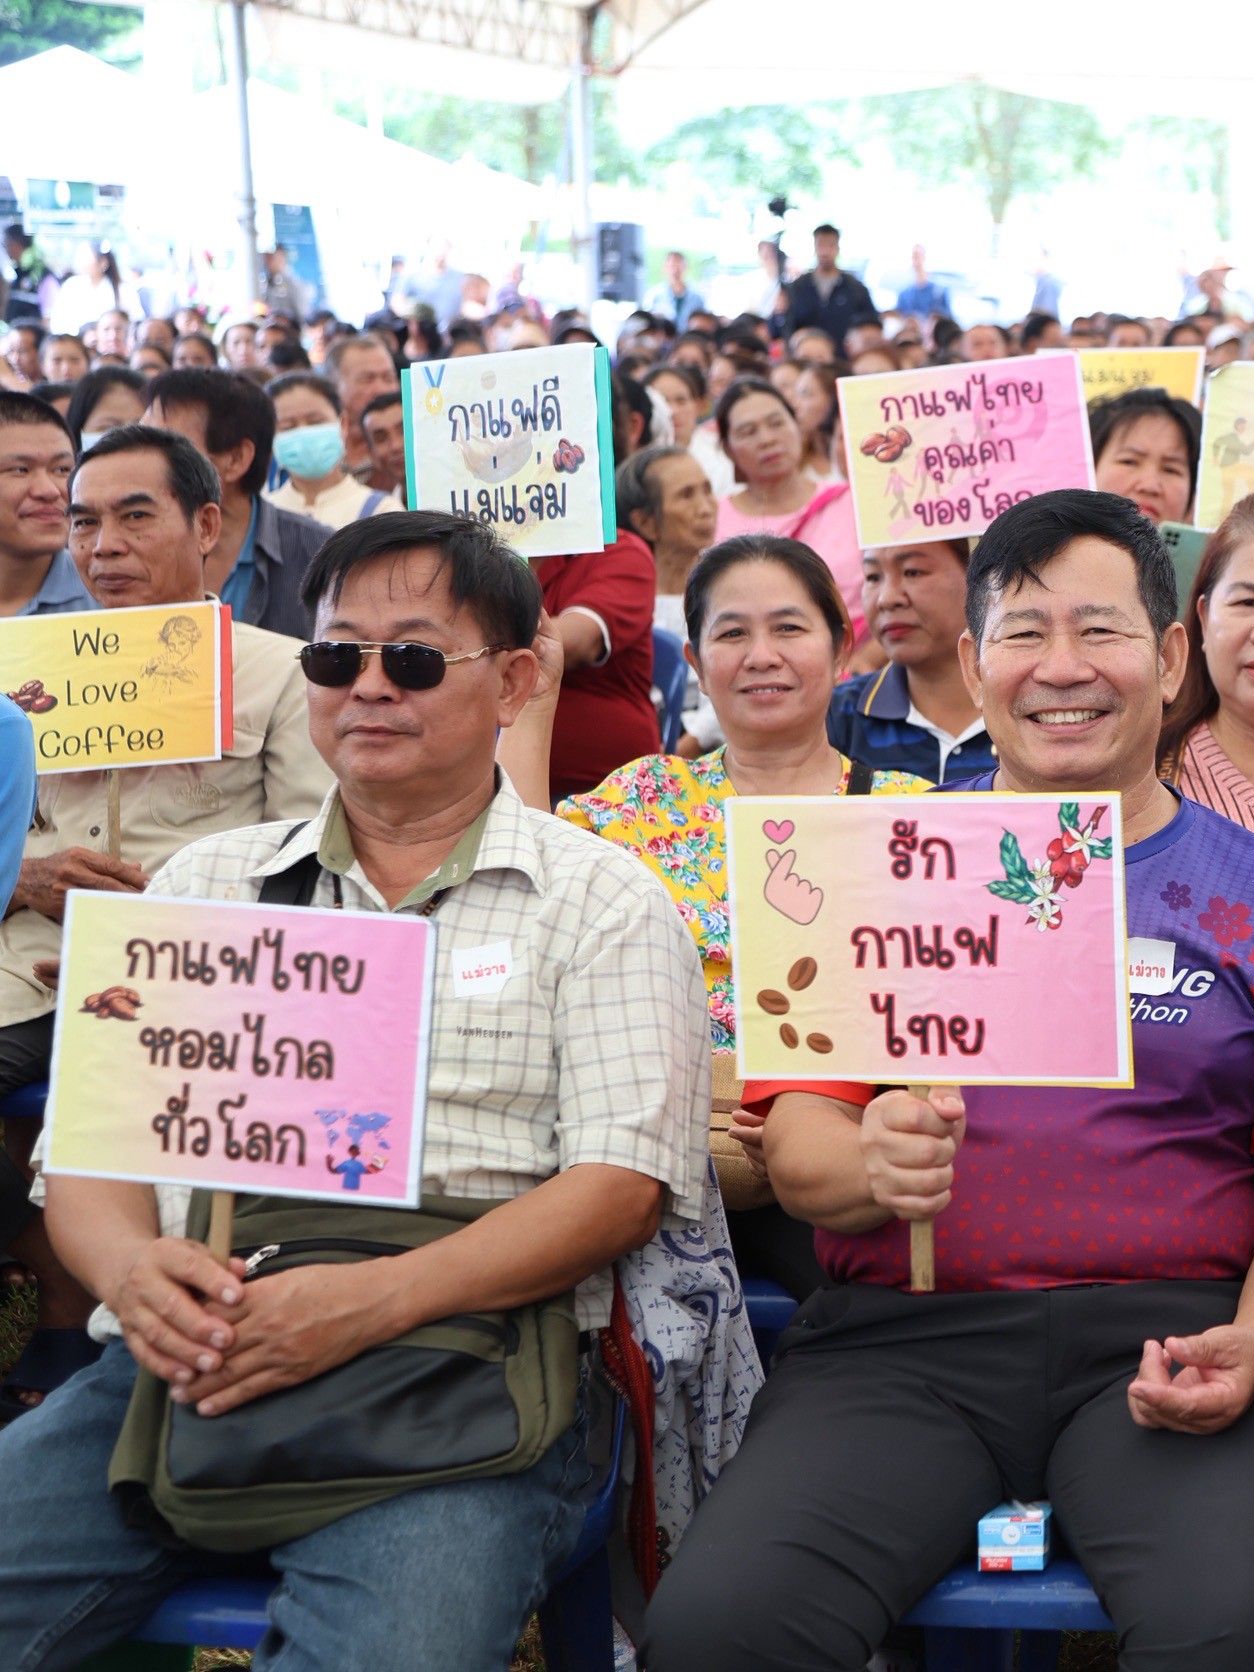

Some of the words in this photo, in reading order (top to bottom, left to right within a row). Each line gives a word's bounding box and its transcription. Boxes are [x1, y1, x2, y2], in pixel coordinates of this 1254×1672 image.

[448, 376, 562, 442] กาแฟดี
[880, 373, 1043, 422] กาแฟไทย
[924, 419, 1015, 484] คุณค่า
[450, 451, 567, 525] แม่แจ่ม
[73, 626, 120, 656] We
[66, 679, 139, 707] Love
[38, 723, 165, 759] Coffee
[888, 818, 957, 881] รัก
[125, 927, 365, 995] กาแฟไทย
[462, 964, 507, 980] แม่วาง
[850, 913, 1000, 970] กาแฟ
[138, 1012, 335, 1081] หอมไกล
[869, 992, 986, 1059] ไทย
[151, 1083, 307, 1168] ทั่วโลก
